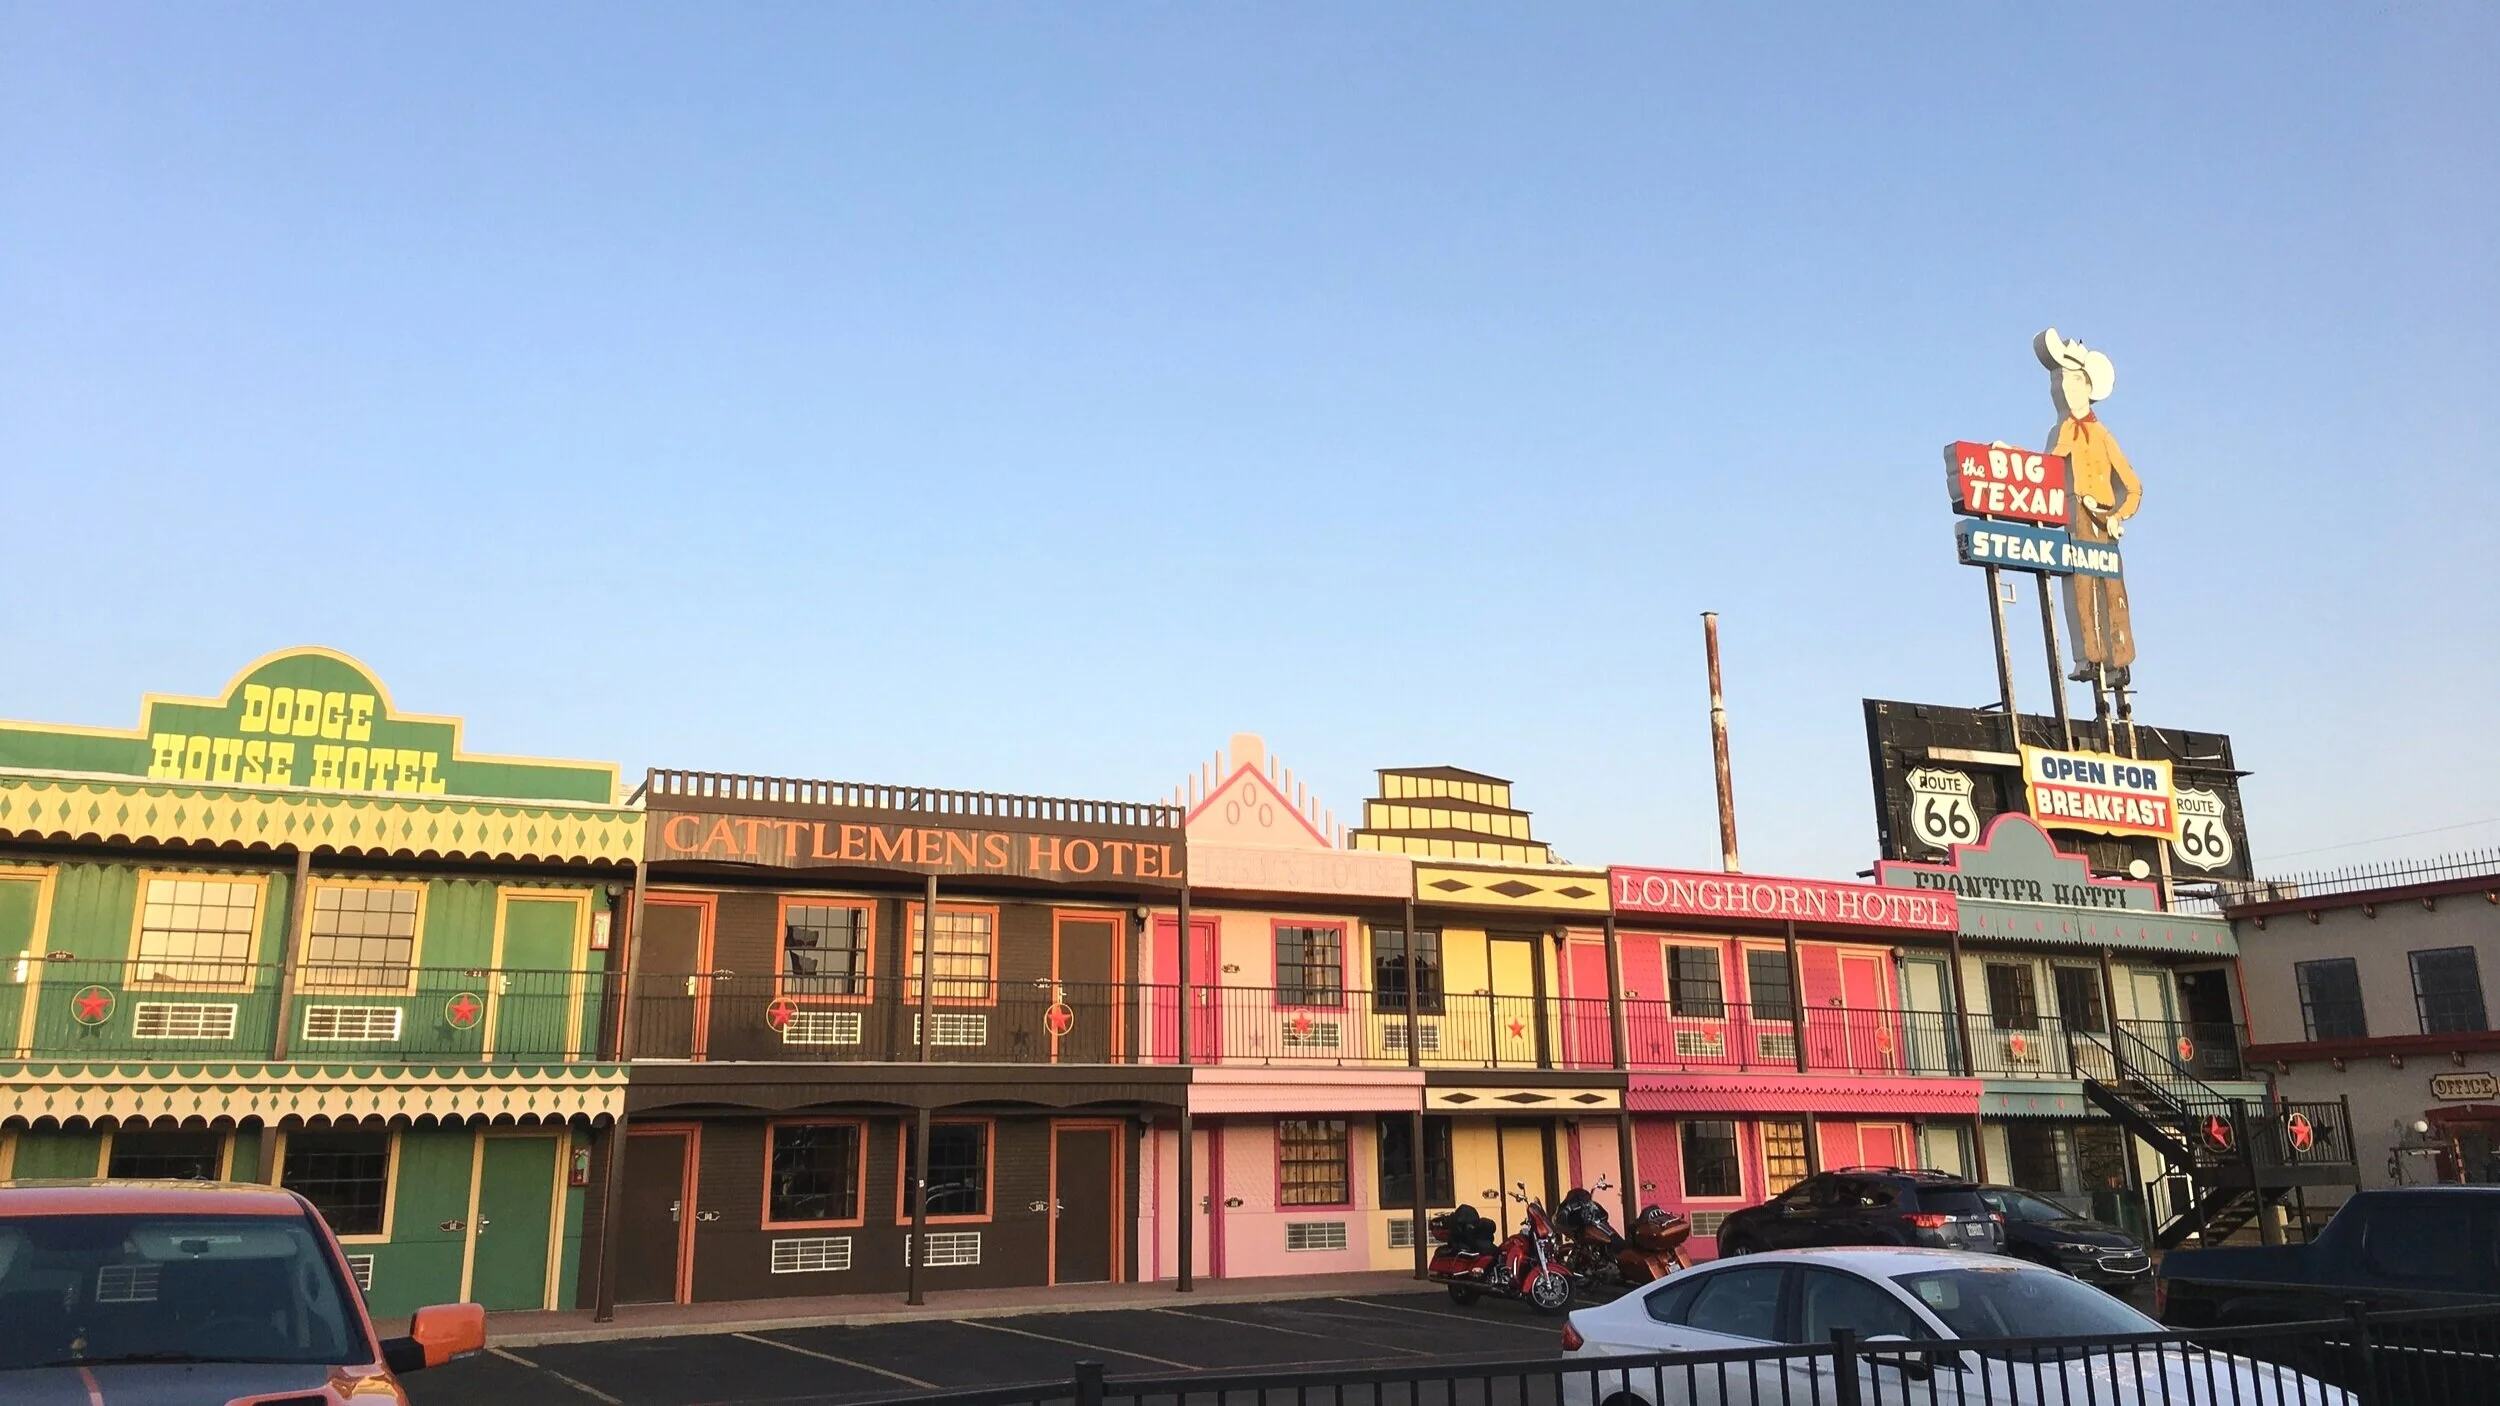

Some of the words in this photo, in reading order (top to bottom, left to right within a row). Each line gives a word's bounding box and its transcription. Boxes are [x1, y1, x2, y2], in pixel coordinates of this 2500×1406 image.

[1961, 456, 1985, 478] the
[1988, 450, 2045, 483] BIG
[1970, 480, 2065, 516] TEXAN
[1973, 531, 2056, 566] STEAK
[2062, 543, 2119, 573] RANCH
[239, 683, 375, 742] DODGE
[148, 732, 295, 785] HOUSE
[310, 744, 446, 795] HOTEL
[1919, 775, 1962, 791] ROUTE
[2041, 756, 2107, 785] OPEN
[2113, 764, 2158, 790] FOR
[1924, 796, 1971, 839] 66
[2035, 787, 2167, 828] BREAKFAST
[2177, 797, 2215, 813] ROUTE
[663, 815, 1009, 868] CATTLEMENS
[1028, 836, 1183, 880] HOTEL
[2182, 818, 2224, 858] 66
[1617, 875, 1826, 917] LONGHORN
[1834, 890, 1950, 926] HOTEL
[2435, 1079, 2493, 1095] OFFICE
